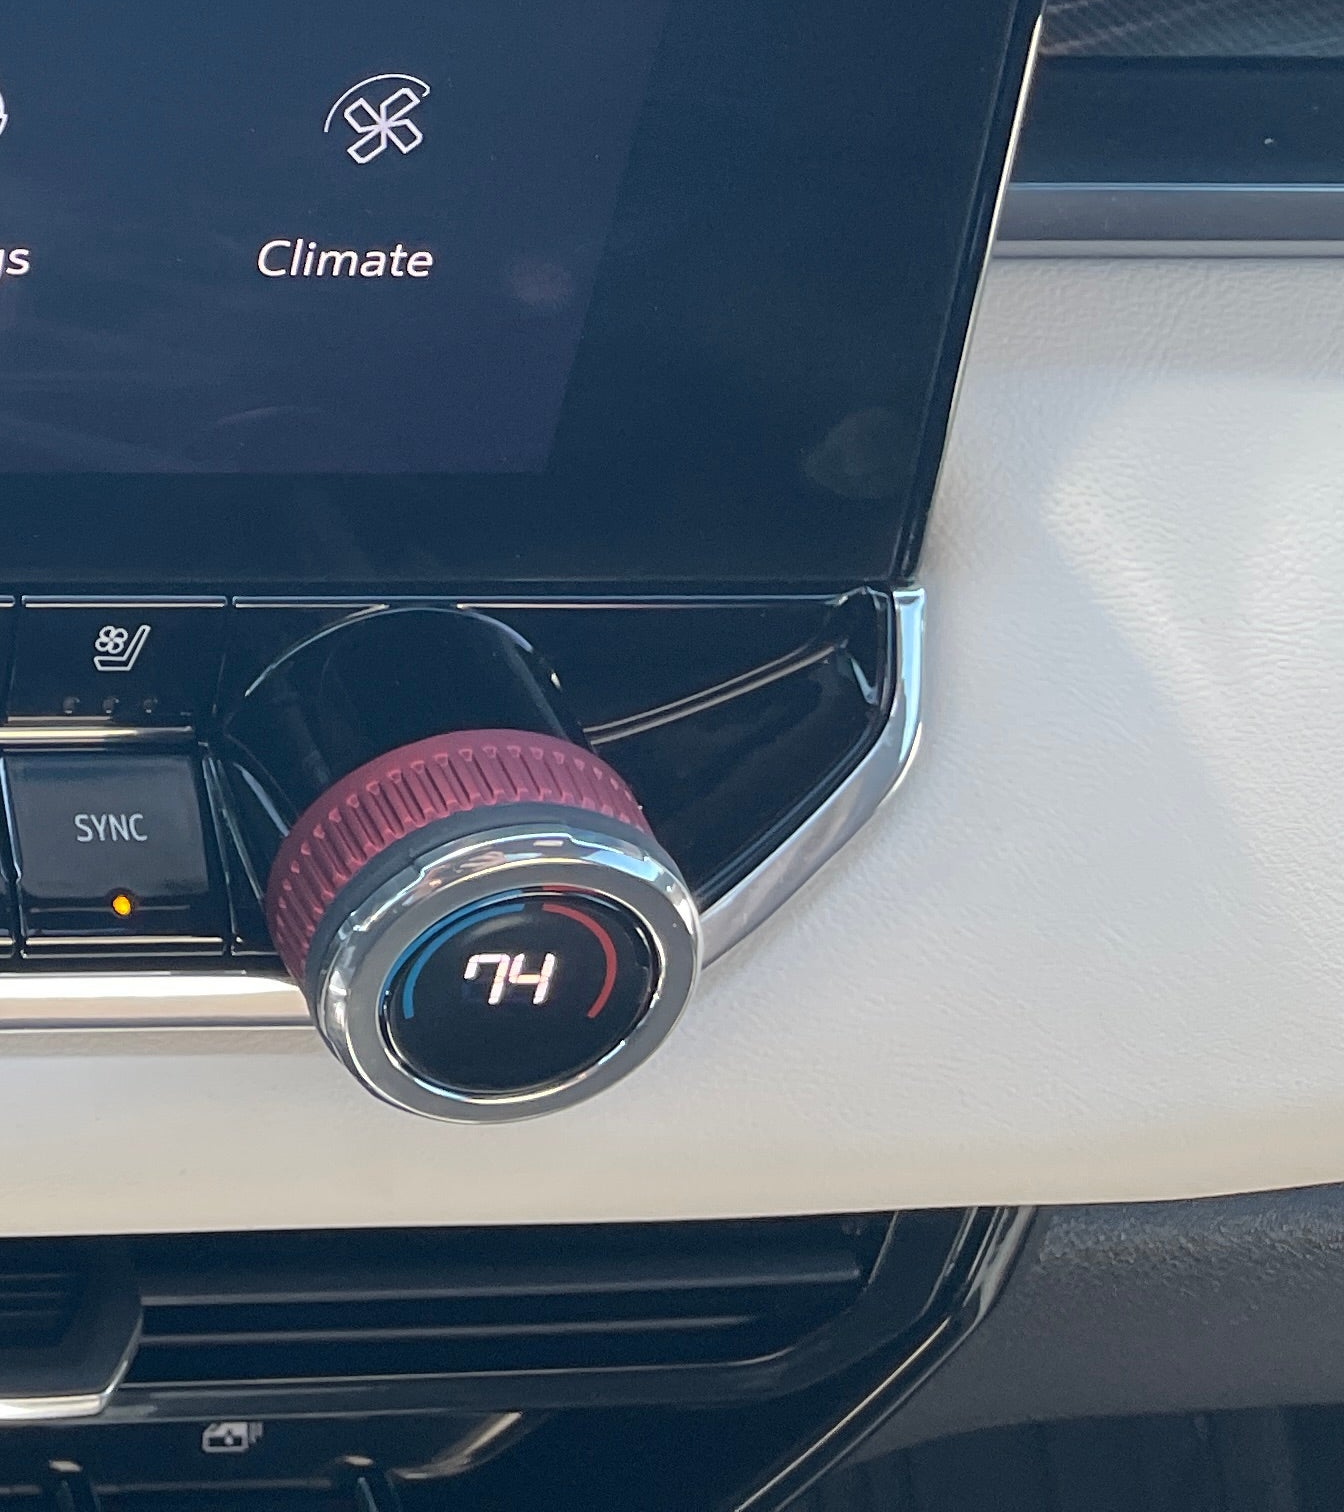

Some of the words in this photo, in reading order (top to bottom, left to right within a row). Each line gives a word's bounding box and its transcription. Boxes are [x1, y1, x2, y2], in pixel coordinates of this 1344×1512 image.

[257, 238, 433, 277] Climate
[74, 813, 148, 842] SYNC
[463, 952, 557, 1006] 74
